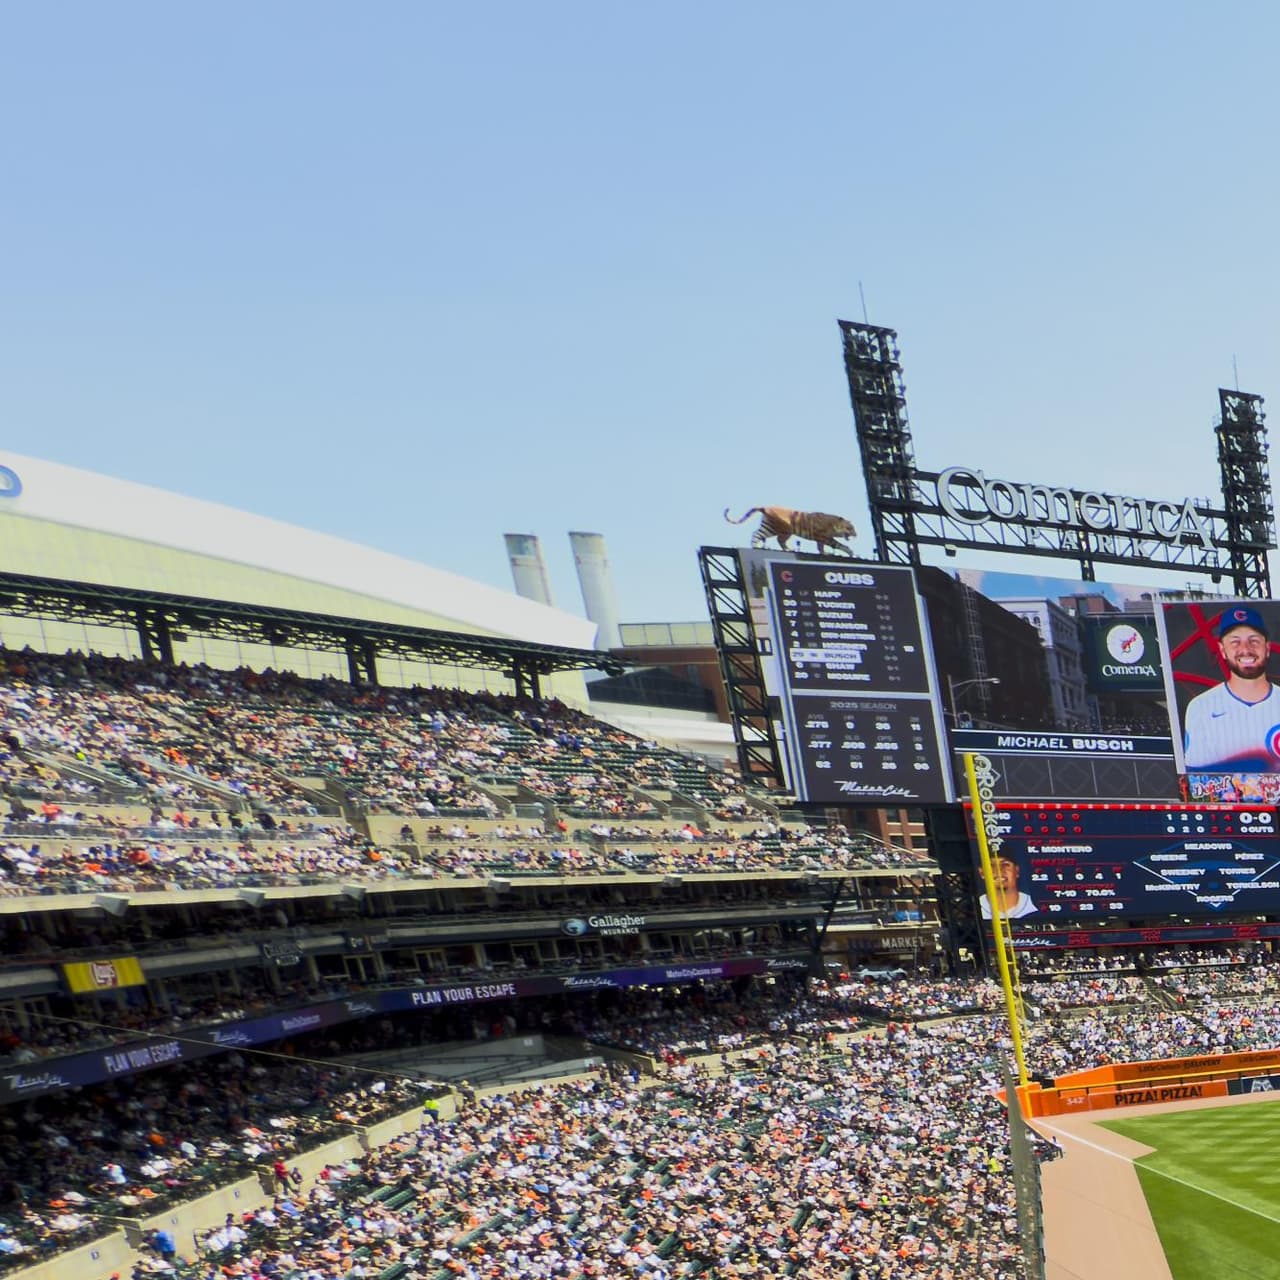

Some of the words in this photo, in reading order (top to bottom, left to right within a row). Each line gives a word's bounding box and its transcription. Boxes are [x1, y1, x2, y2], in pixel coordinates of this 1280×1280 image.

[1026, 526, 1150, 557] PARK
[824, 572, 874, 585] CUBS
[814, 590, 842, 598] HAPP
[816, 601, 855, 610] TUCKER
[860, 702, 897, 710] SEASON
[998, 735, 1067, 749] MICHAEL
[1072, 738, 1133, 751] BUSCH
[589, 914, 645, 928] Gallagher
[600, 928, 639, 936] INSURANCE
[881, 936, 924, 949] MARKET
[412, 992, 441, 1005] PLAN
[443, 988, 474, 1002] YOUR
[476, 984, 516, 999] ESCAPE
[104, 1055, 130, 1072] PLAN
[1115, 1087, 1159, 1106] PIZZA!
[1161, 1085, 1203, 1101] PIZZA!
